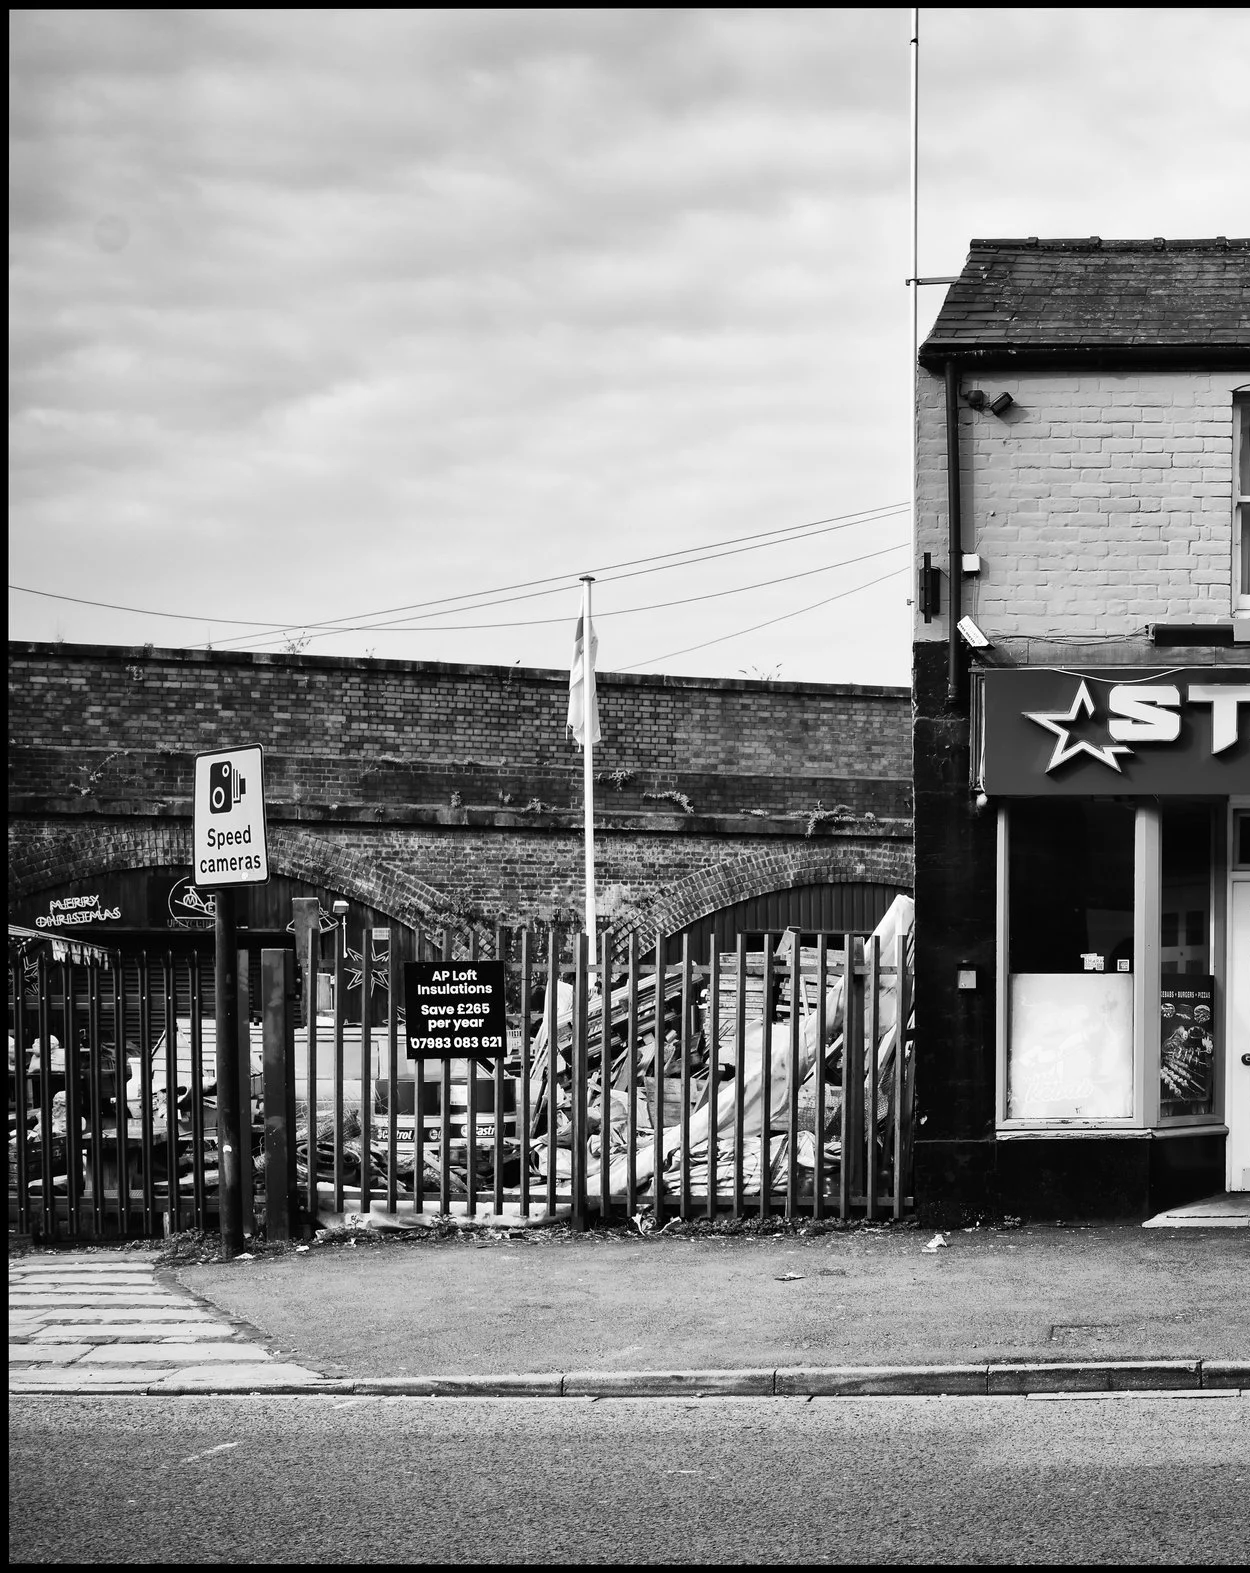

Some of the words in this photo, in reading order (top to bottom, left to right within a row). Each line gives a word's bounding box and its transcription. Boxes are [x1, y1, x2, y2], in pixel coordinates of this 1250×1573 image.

[206, 824, 252, 850] Speed
[200, 854, 261, 874] cameras
[50, 895, 99, 911] MERRY
[431, 970, 450, 981] AP
[452, 968, 478, 981] Loft
[417, 982, 493, 995] Insulations
[1197, 991, 1211, 999] PIZZAS
[421, 1004, 455, 1015] Save
[456, 1002, 490, 1015] £265
[428, 1018, 451, 1032] per
[452, 1018, 484, 1032] year
[410, 1037, 452, 1049] 07983
[453, 1036, 479, 1049] 083
[481, 1036, 502, 1048] 621
